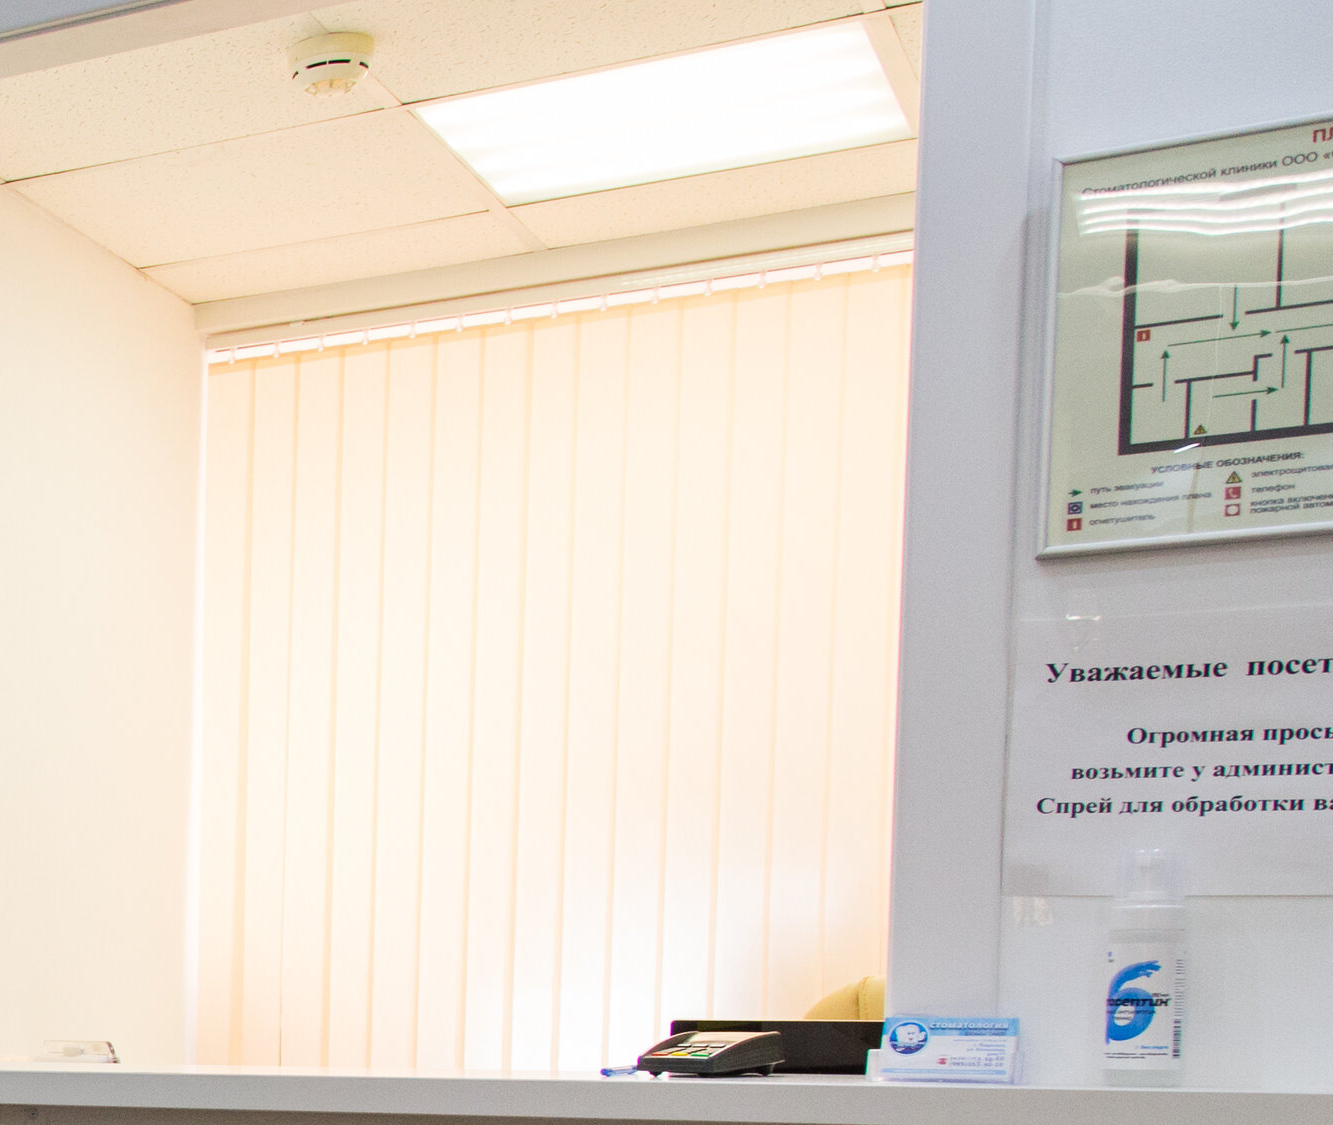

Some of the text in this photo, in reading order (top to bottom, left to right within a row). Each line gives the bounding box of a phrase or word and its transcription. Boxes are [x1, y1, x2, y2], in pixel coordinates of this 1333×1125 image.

[1220, 160, 1278, 177] клиники
[1282, 152, 1318, 167] ООО
[1150, 452, 1305, 474] УСЛОВНЫЕ ОБОЗНАЧЕНИЯ:
[1046, 662, 1230, 684] Уважаемые
[1127, 727, 1255, 748] Огромная
[1071, 766, 1185, 780] возьмите
[1191, 766, 1205, 782] у
[1037, 797, 1113, 819] Спрей
[1119, 801, 1164, 816] для
[1171, 795, 1305, 817] обработки
